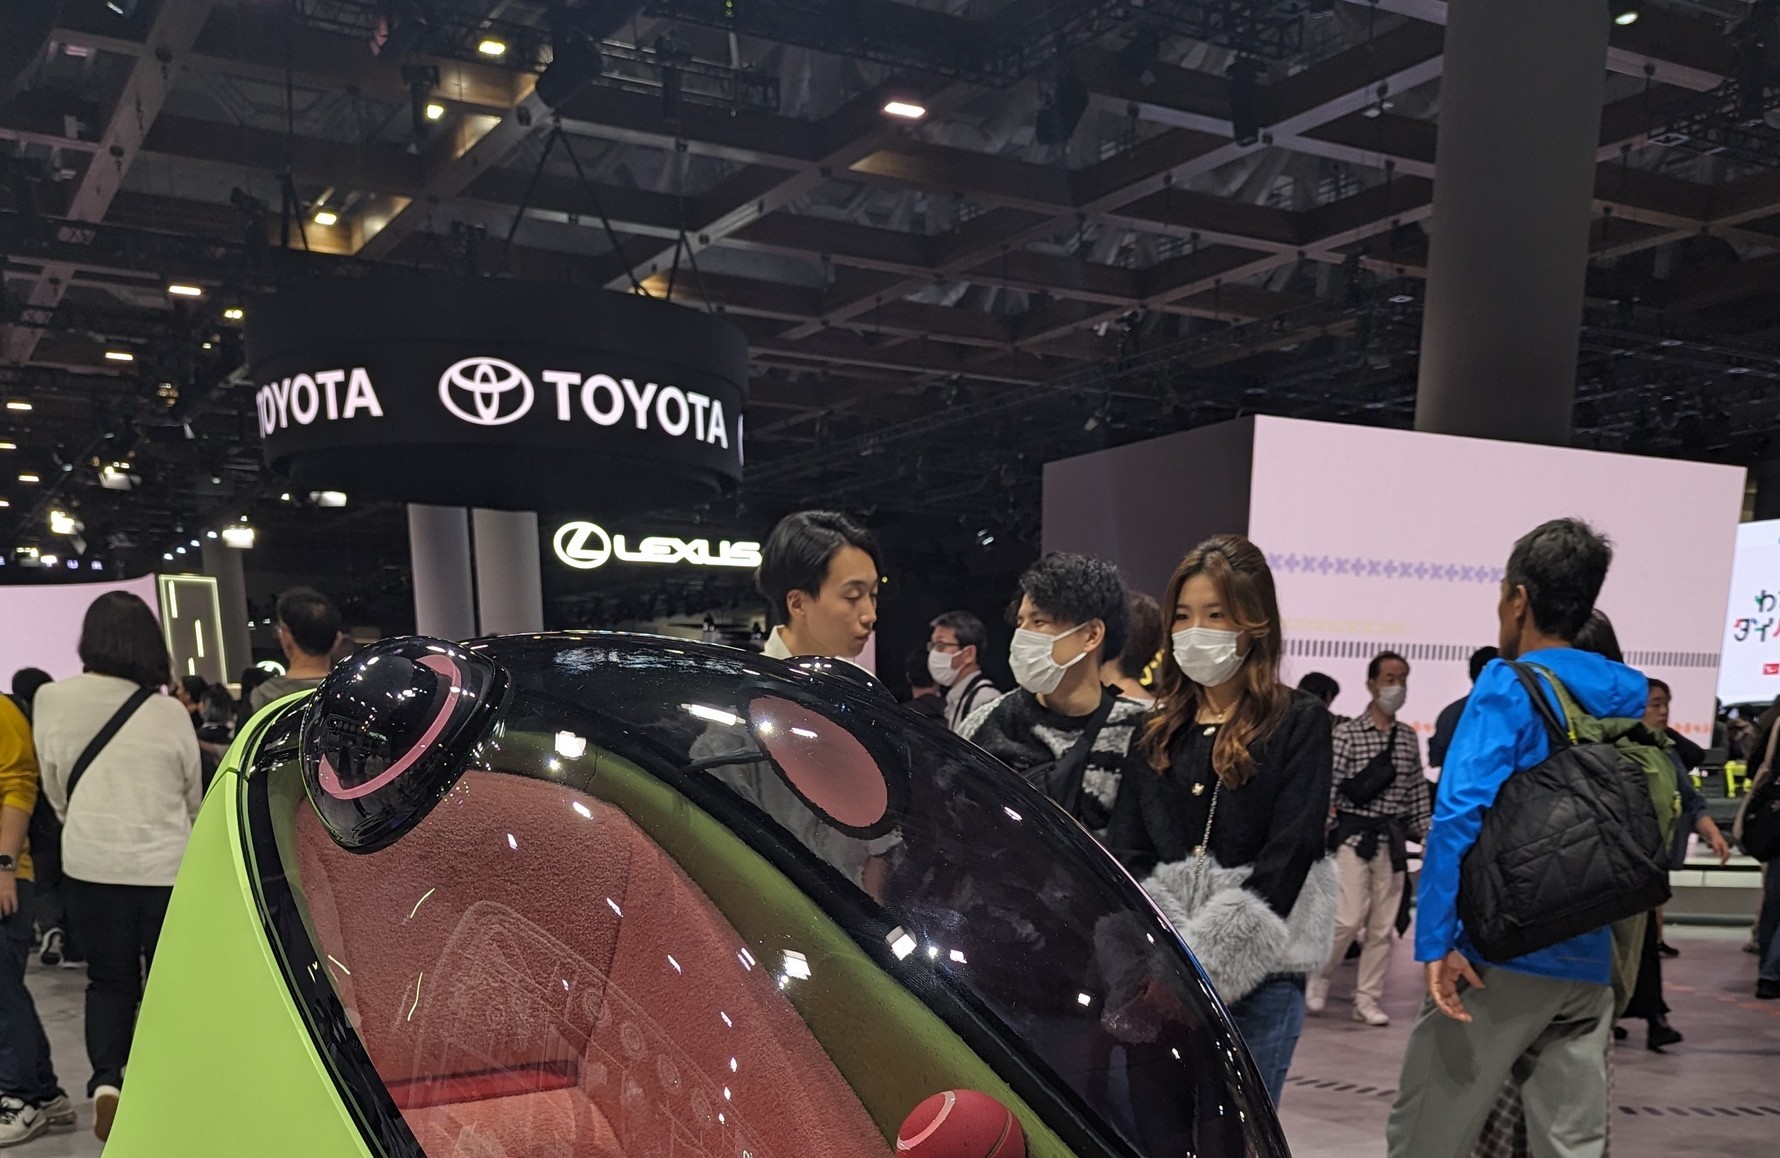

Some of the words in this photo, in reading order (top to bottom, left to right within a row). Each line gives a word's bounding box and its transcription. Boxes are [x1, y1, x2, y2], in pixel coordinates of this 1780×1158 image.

[542, 370, 729, 450] TOYOTA
[613, 534, 763, 567] LEXUS
[1754, 589, 1780, 613] わ
